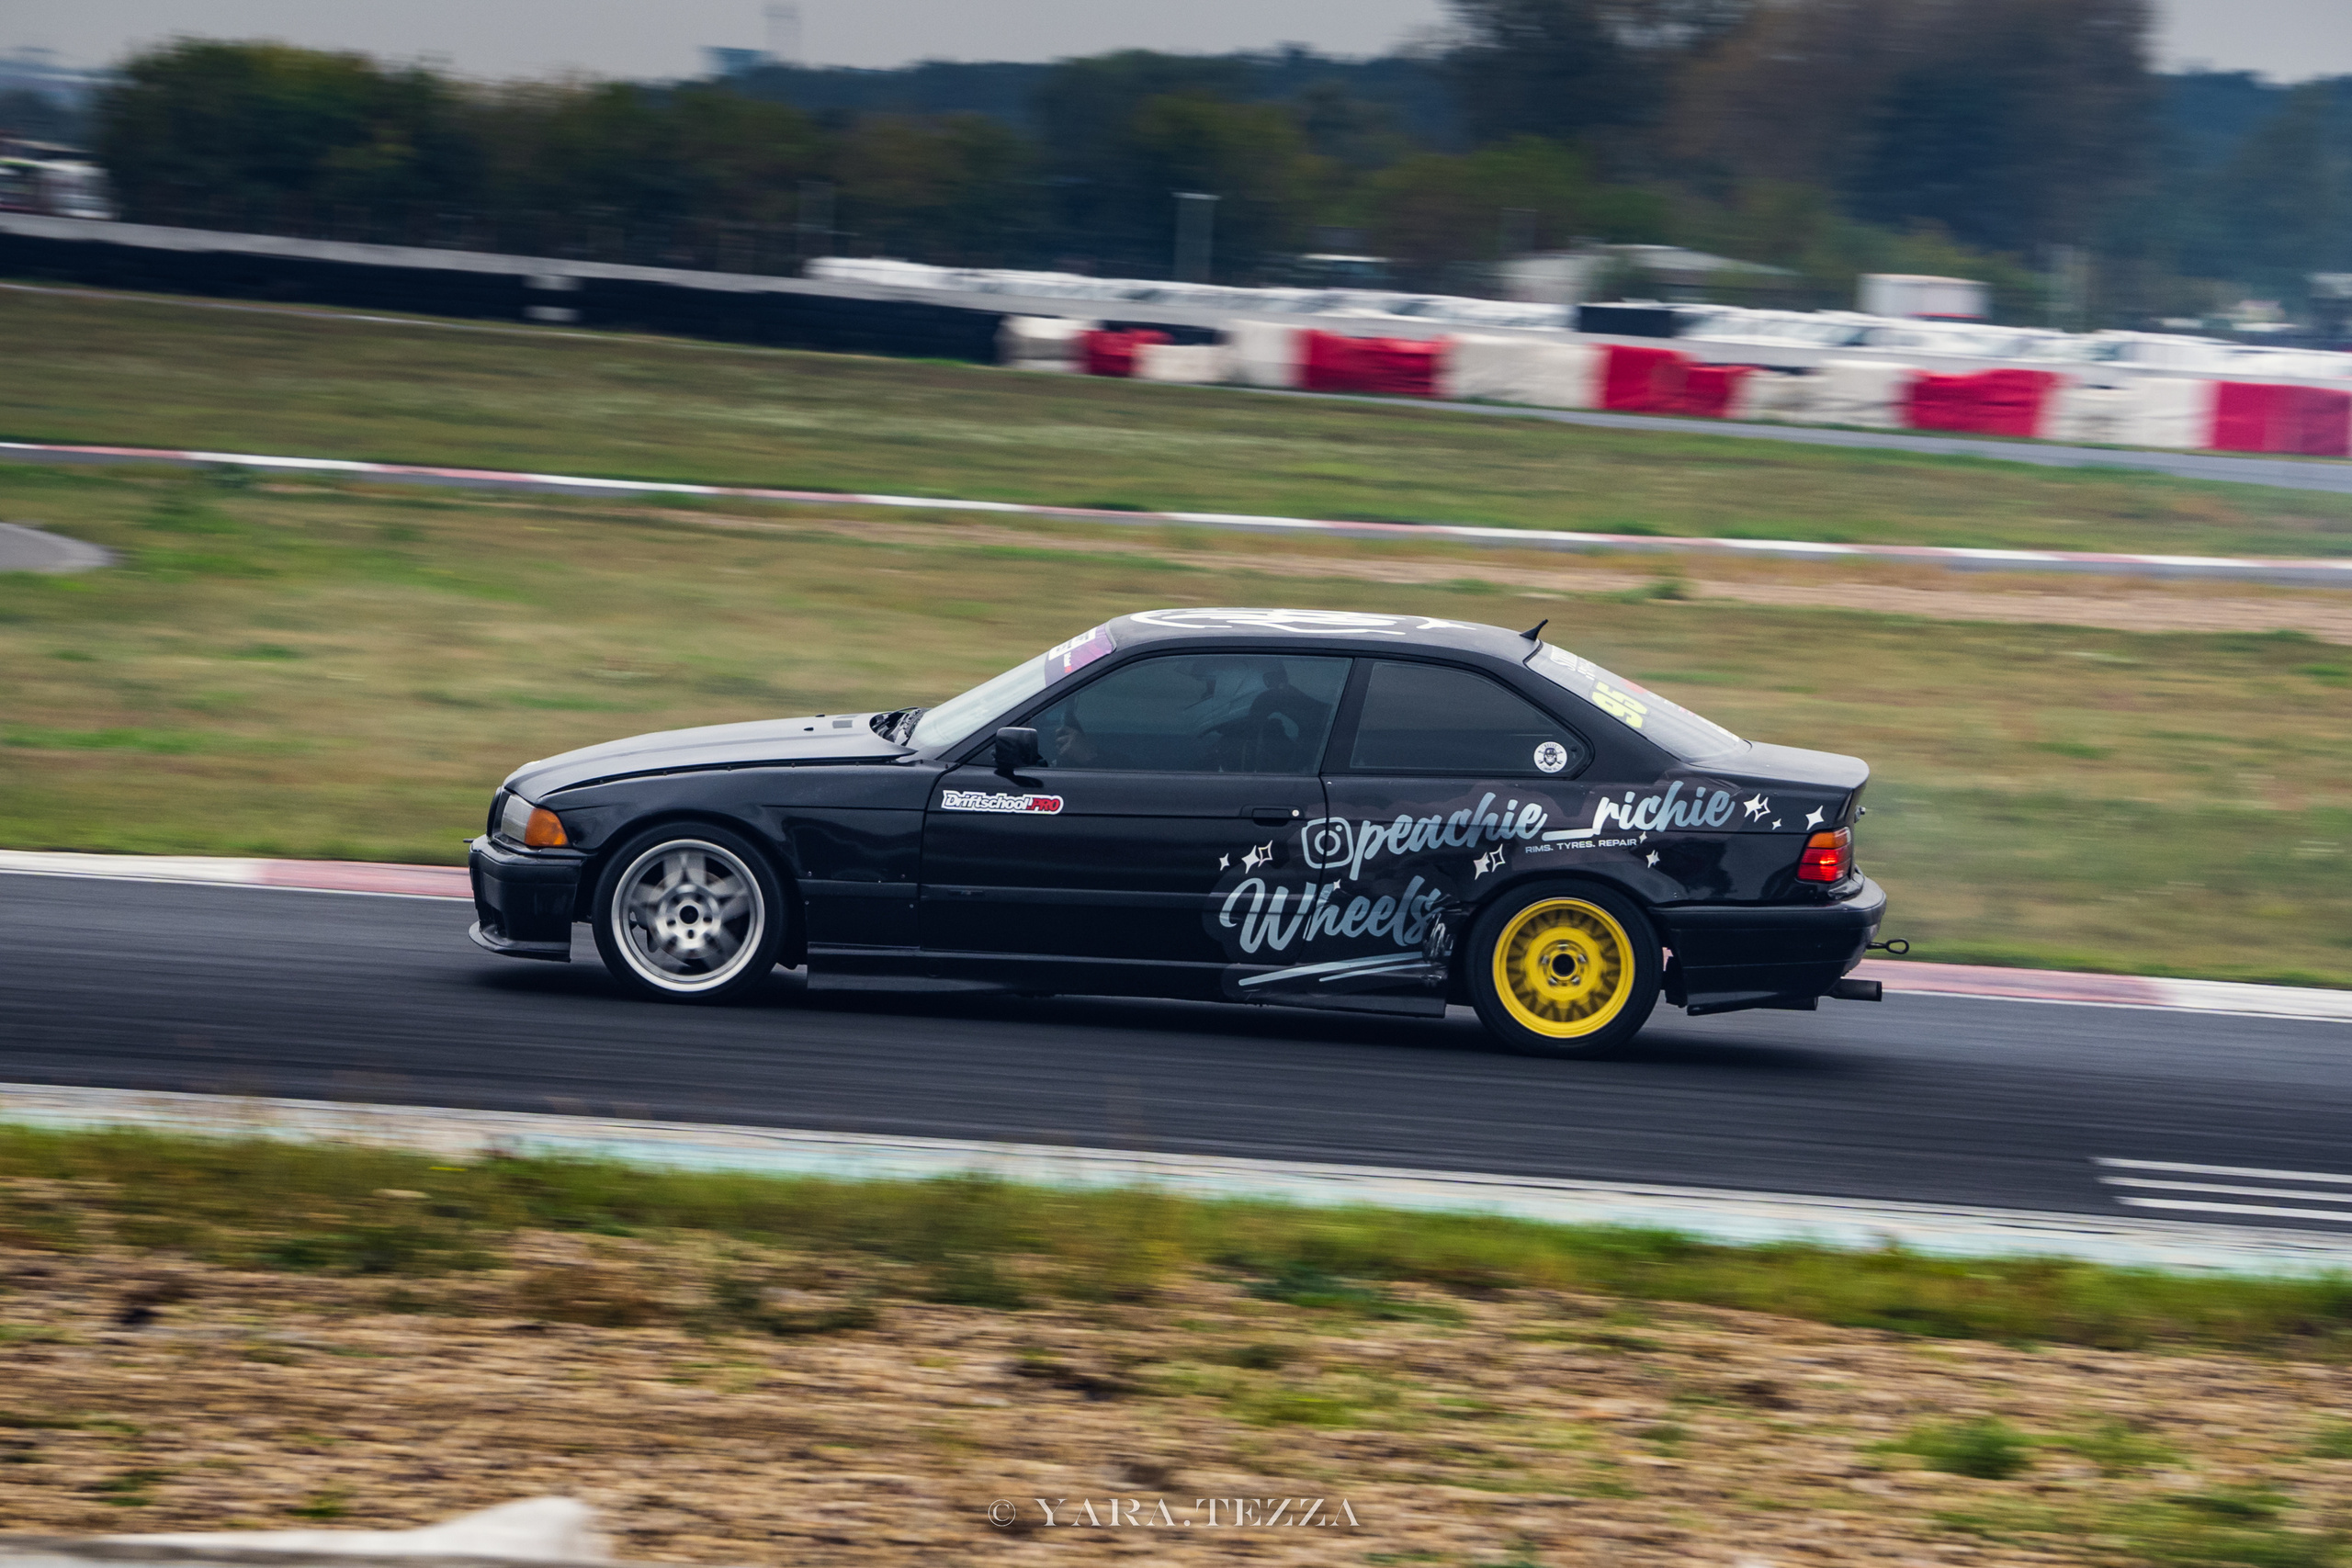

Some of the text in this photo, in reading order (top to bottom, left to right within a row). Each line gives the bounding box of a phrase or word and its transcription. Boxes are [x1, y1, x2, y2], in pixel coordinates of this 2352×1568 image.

[944, 793, 1061, 812] Driftschool.PRO
[1524, 838, 1637, 854] RIMS. TYRES. REPAIR
[1219, 874, 1442, 953] Wheels
